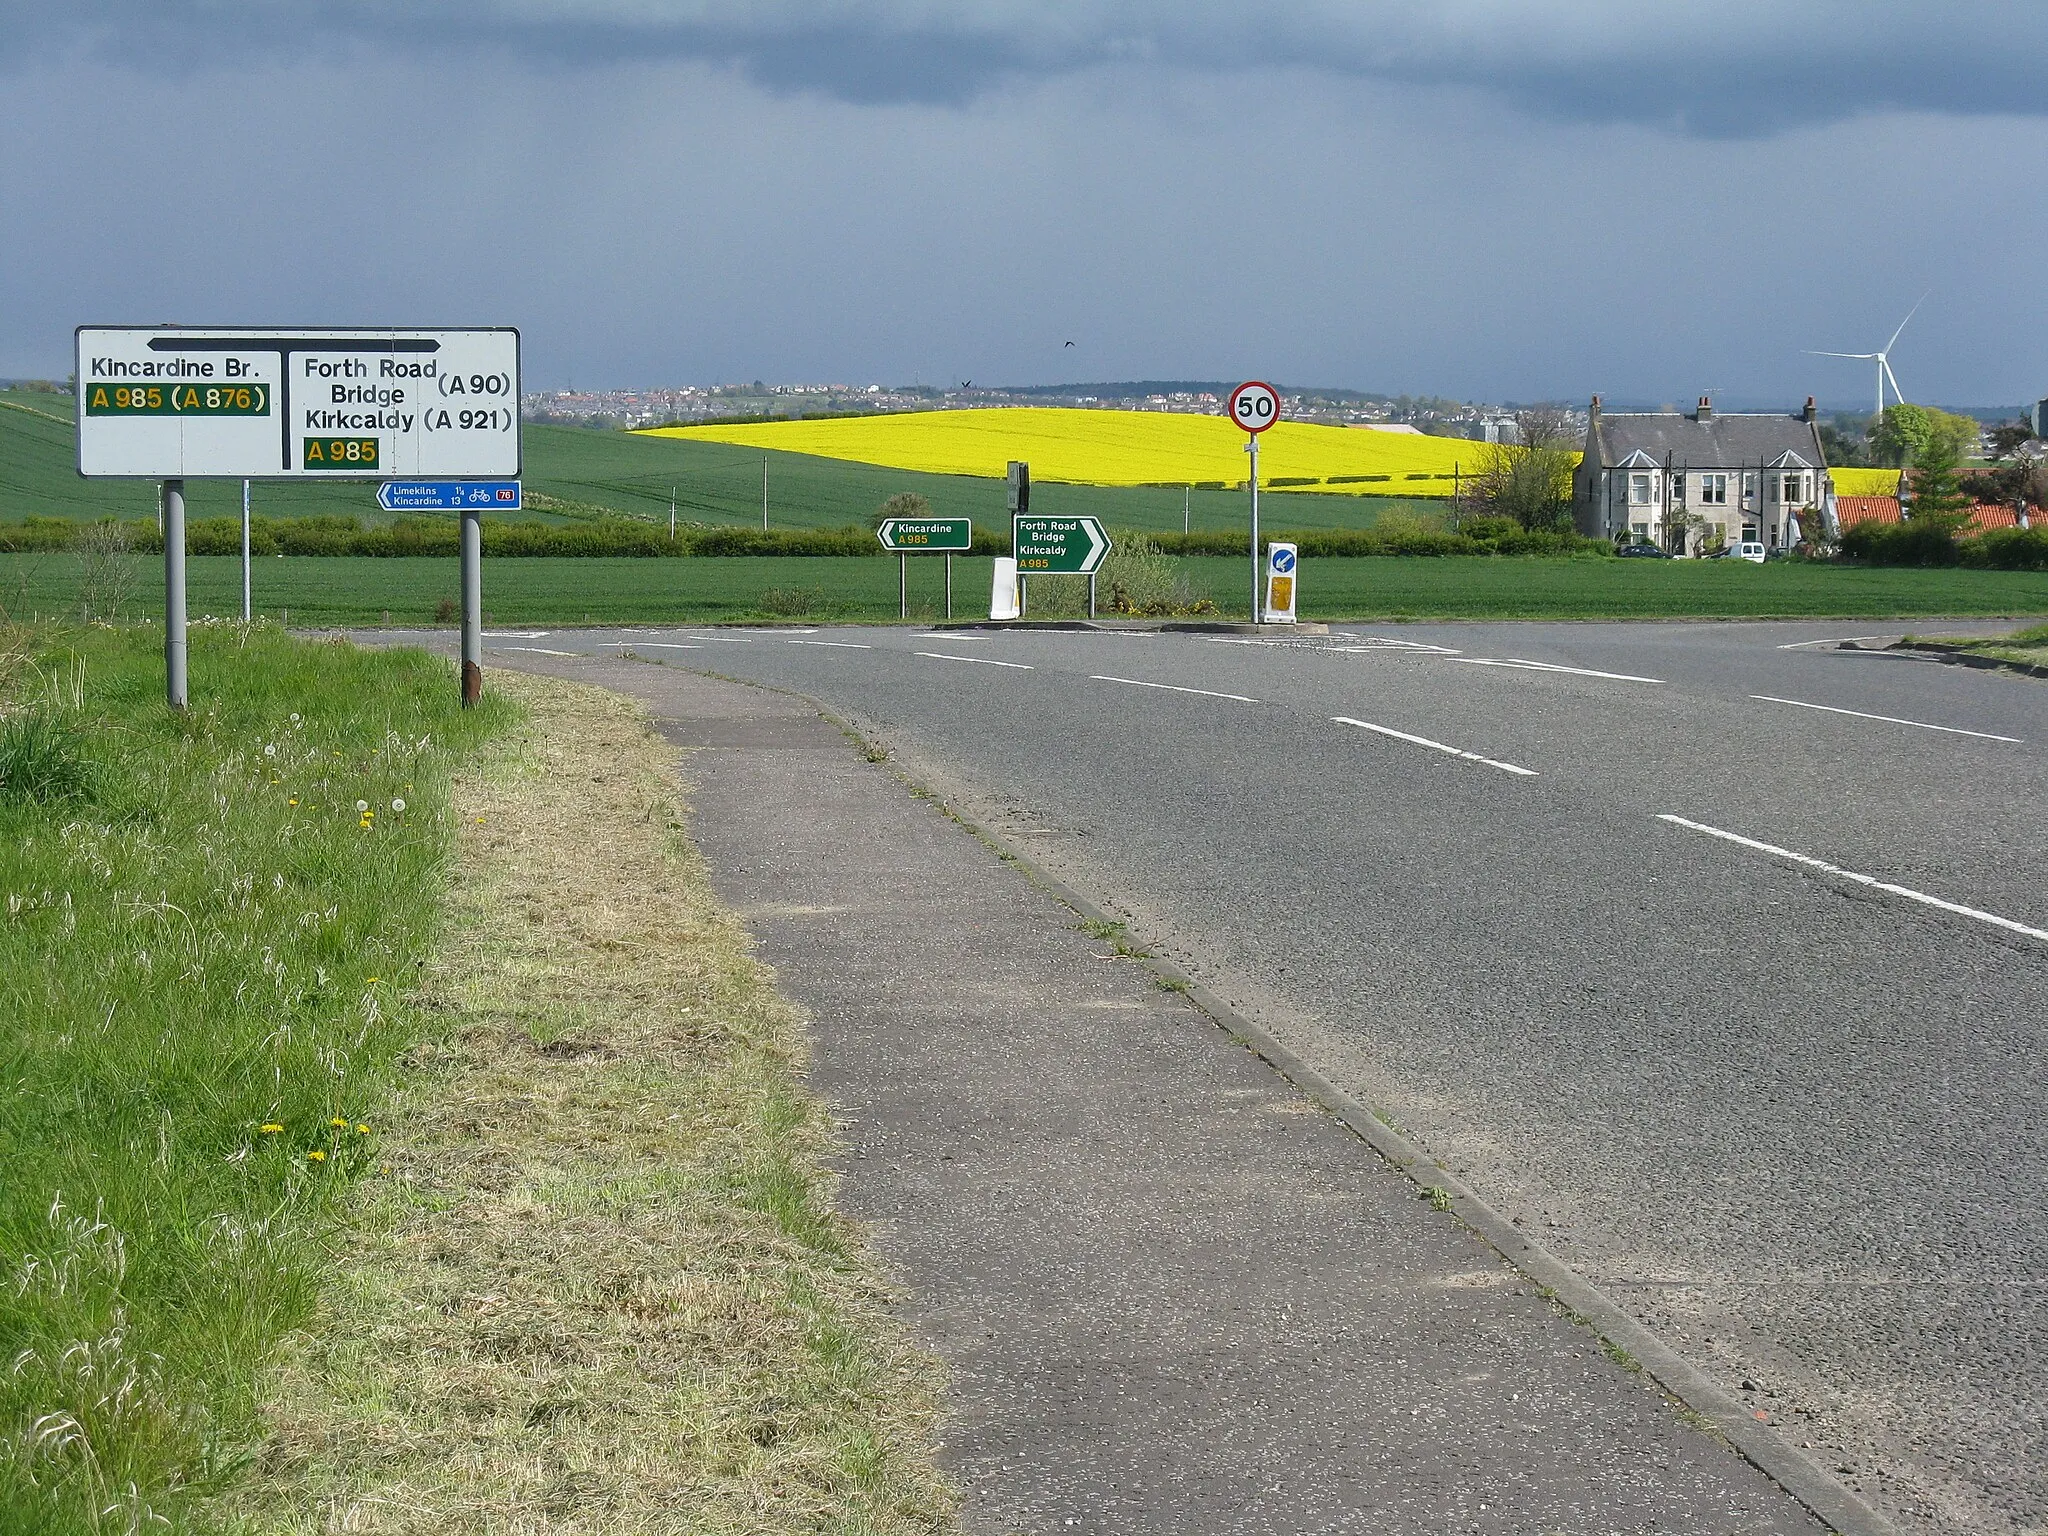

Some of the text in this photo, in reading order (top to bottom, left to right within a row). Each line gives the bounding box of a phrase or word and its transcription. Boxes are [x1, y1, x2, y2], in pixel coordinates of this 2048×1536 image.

[92, 357, 260, 377] Kincardine Br.
[305, 359, 436, 378] Forth Road
[332, 384, 405, 408] Bridge
[1238, 396, 1272, 417] 50
[306, 409, 414, 433] Kirkcaldy
[393, 487, 436, 496] Limekilns
[500, 491, 511, 499] 76
[393, 497, 461, 506] Kincardine 13
[898, 524, 952, 533] Kincardine
[1020, 522, 1076, 530] Forth Road
[1032, 532, 1065, 542] Bridge
[1020, 546, 1066, 556] Kirkcaldy
